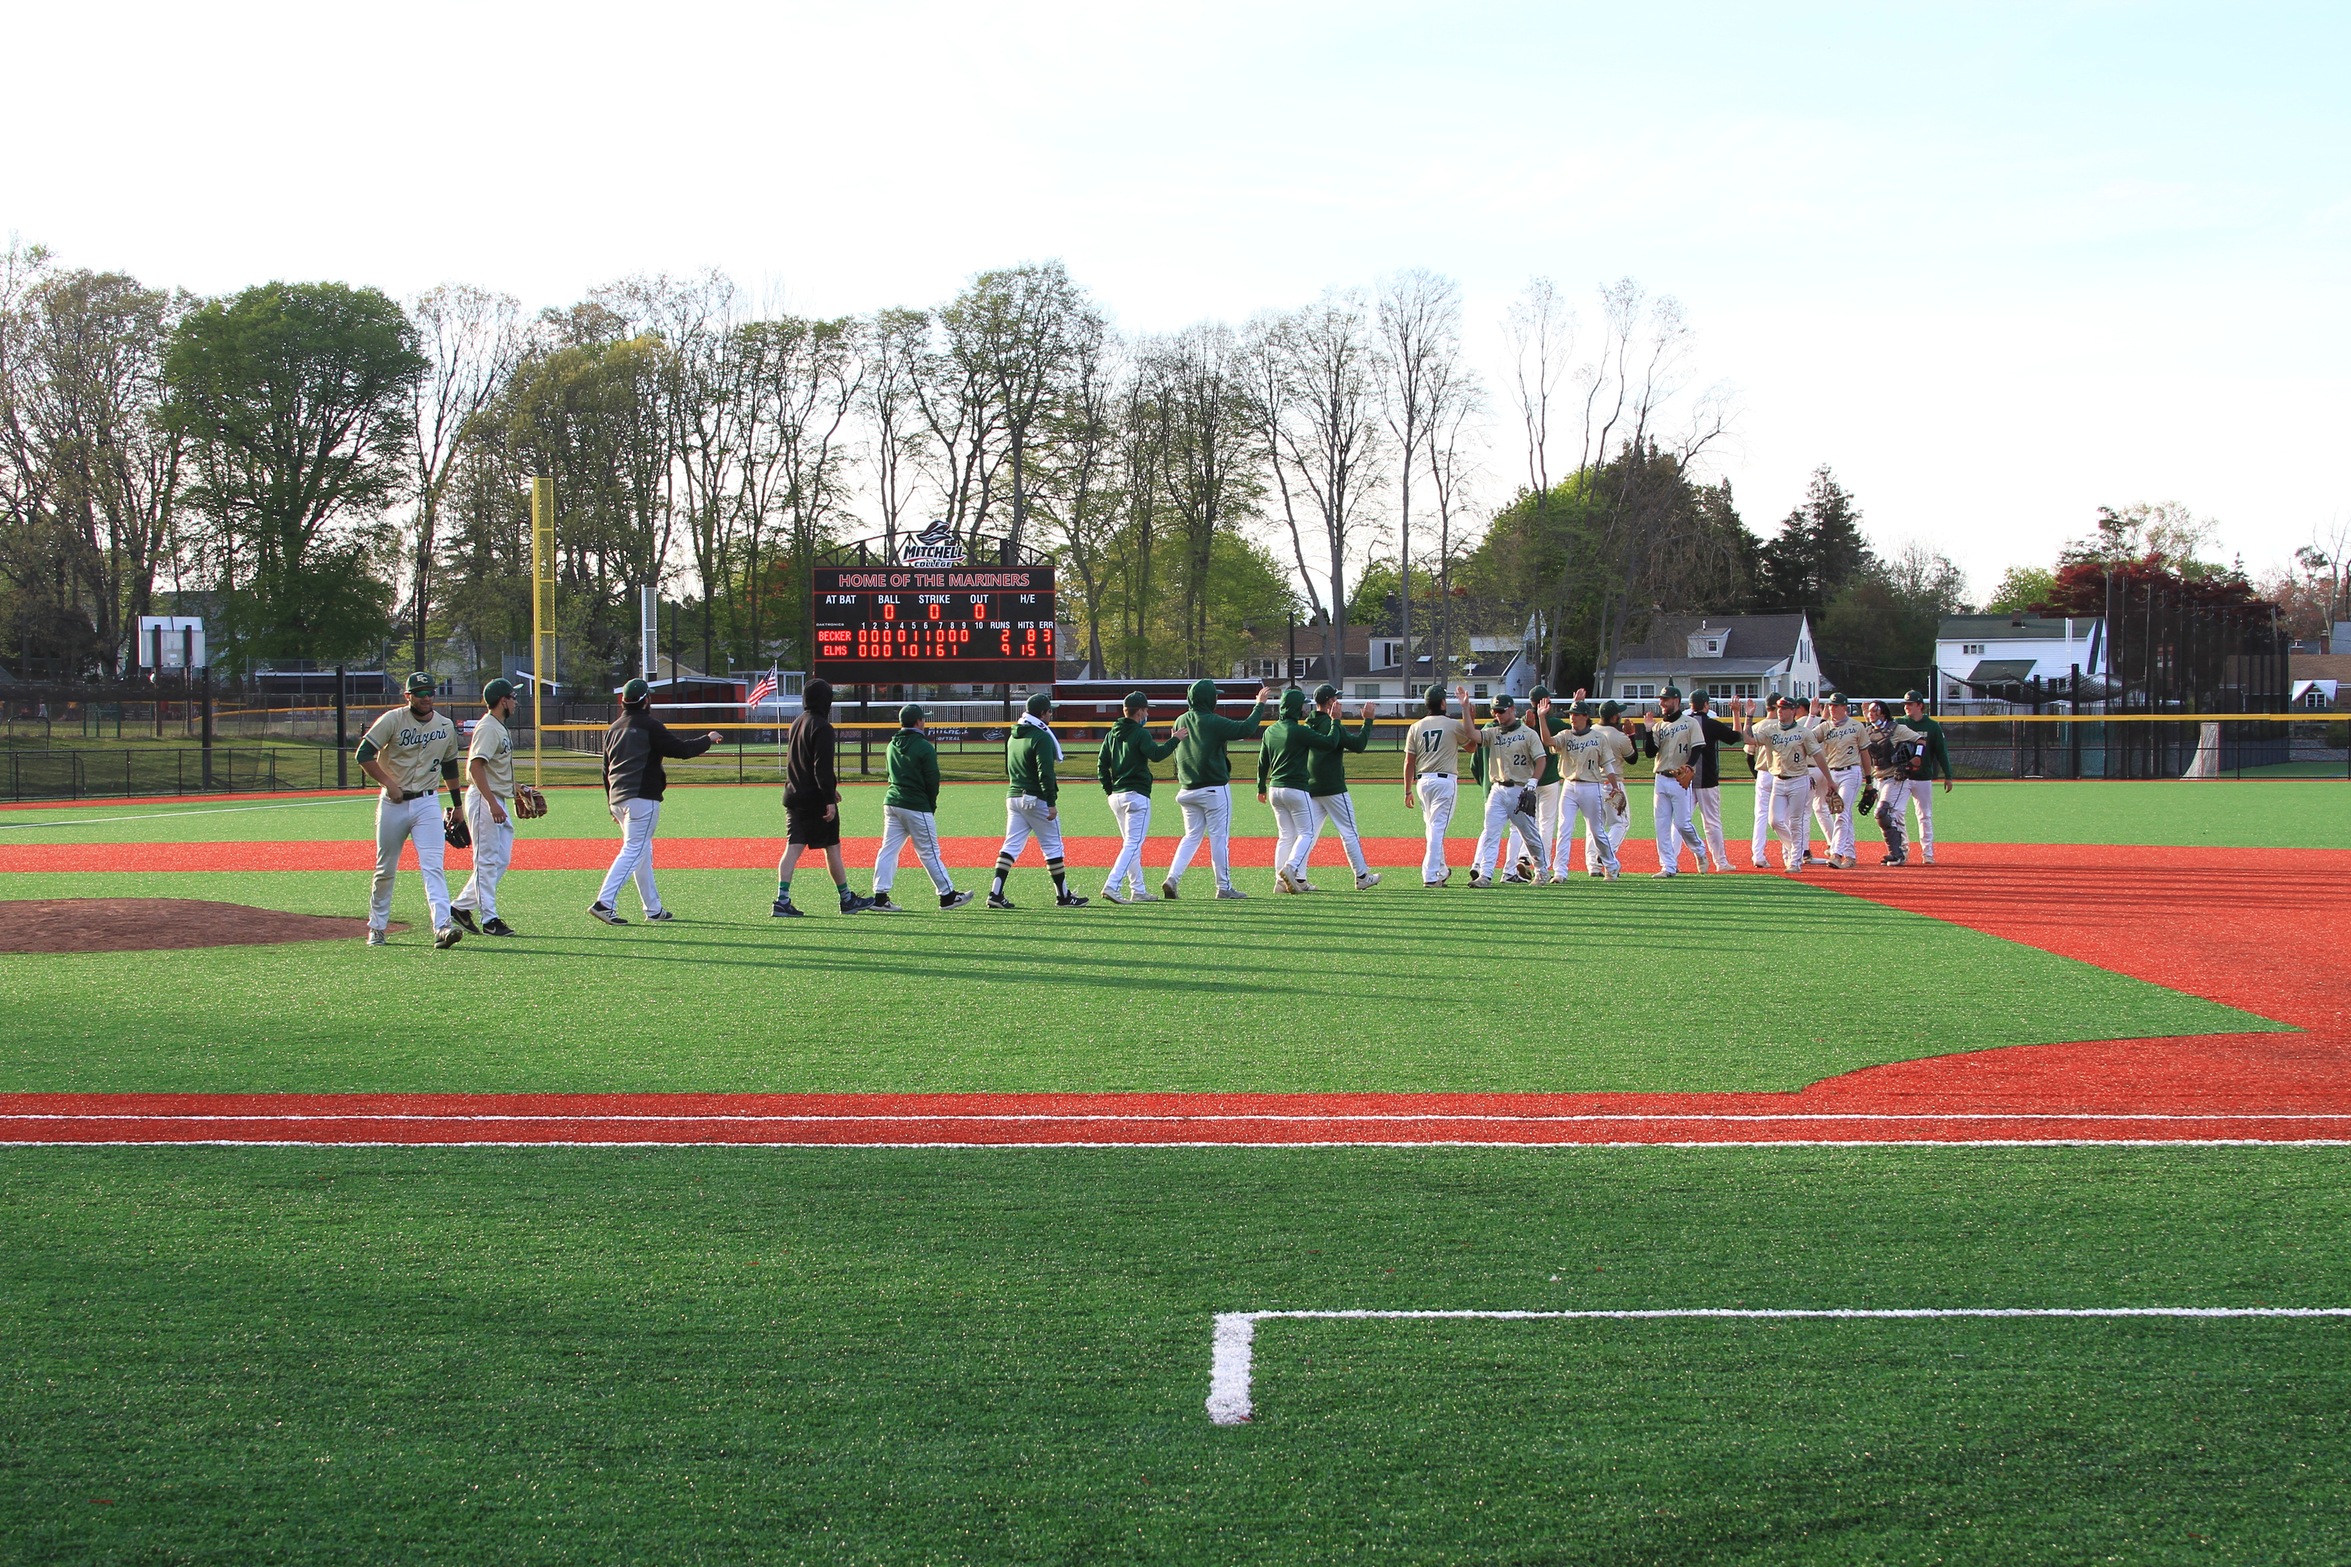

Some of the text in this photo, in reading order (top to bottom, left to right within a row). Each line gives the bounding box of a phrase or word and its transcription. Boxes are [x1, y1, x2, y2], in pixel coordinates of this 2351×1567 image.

[902, 546, 964, 560] MITCHELL
[838, 573, 1030, 587] HOME OF THE MARINERS
[826, 595, 856, 604] AT BAT
[878, 595, 900, 604] BALL
[918, 595, 950, 604] STRIKE
[970, 595, 989, 604] OUT
[1020, 594, 1035, 603] H/E
[884, 604, 894, 619] 0
[930, 604, 939, 619] 0
[975, 604, 984, 619] 0
[818, 631, 852, 642] BECKER
[859, 630, 867, 642] 0
[871, 630, 879, 642] 0
[883, 630, 891, 642] 0
[898, 630, 906, 642] 0
[936, 630, 944, 642] 0
[948, 630, 957, 642] 0
[961, 630, 969, 642] 0
[1002, 630, 1010, 642] 2
[1027, 630, 1036, 642] 8
[1043, 630, 1051, 642] 3
[824, 645, 847, 656] ELMS
[859, 644, 867, 657] 0
[871, 644, 879, 657] 0
[883, 644, 891, 657] 0
[910, 644, 918, 657] 0
[936, 644, 944, 657] 6
[1002, 644, 1010, 657] 9
[1021, 644, 1036, 657] 15
[400, 728, 447, 748] Blazers
[1659, 724, 1688, 740] Blazers
[1825, 727, 1856, 740] Blazers
[1422, 729, 1443, 752] 17
[1566, 738, 1598, 753] Blazers
[1771, 733, 1802, 747] Blazers
[1678, 743, 1688, 753] 14
[1847, 746, 1853, 754] 2
[1513, 754, 1526, 766] 22
[1794, 752, 1800, 762] 8
